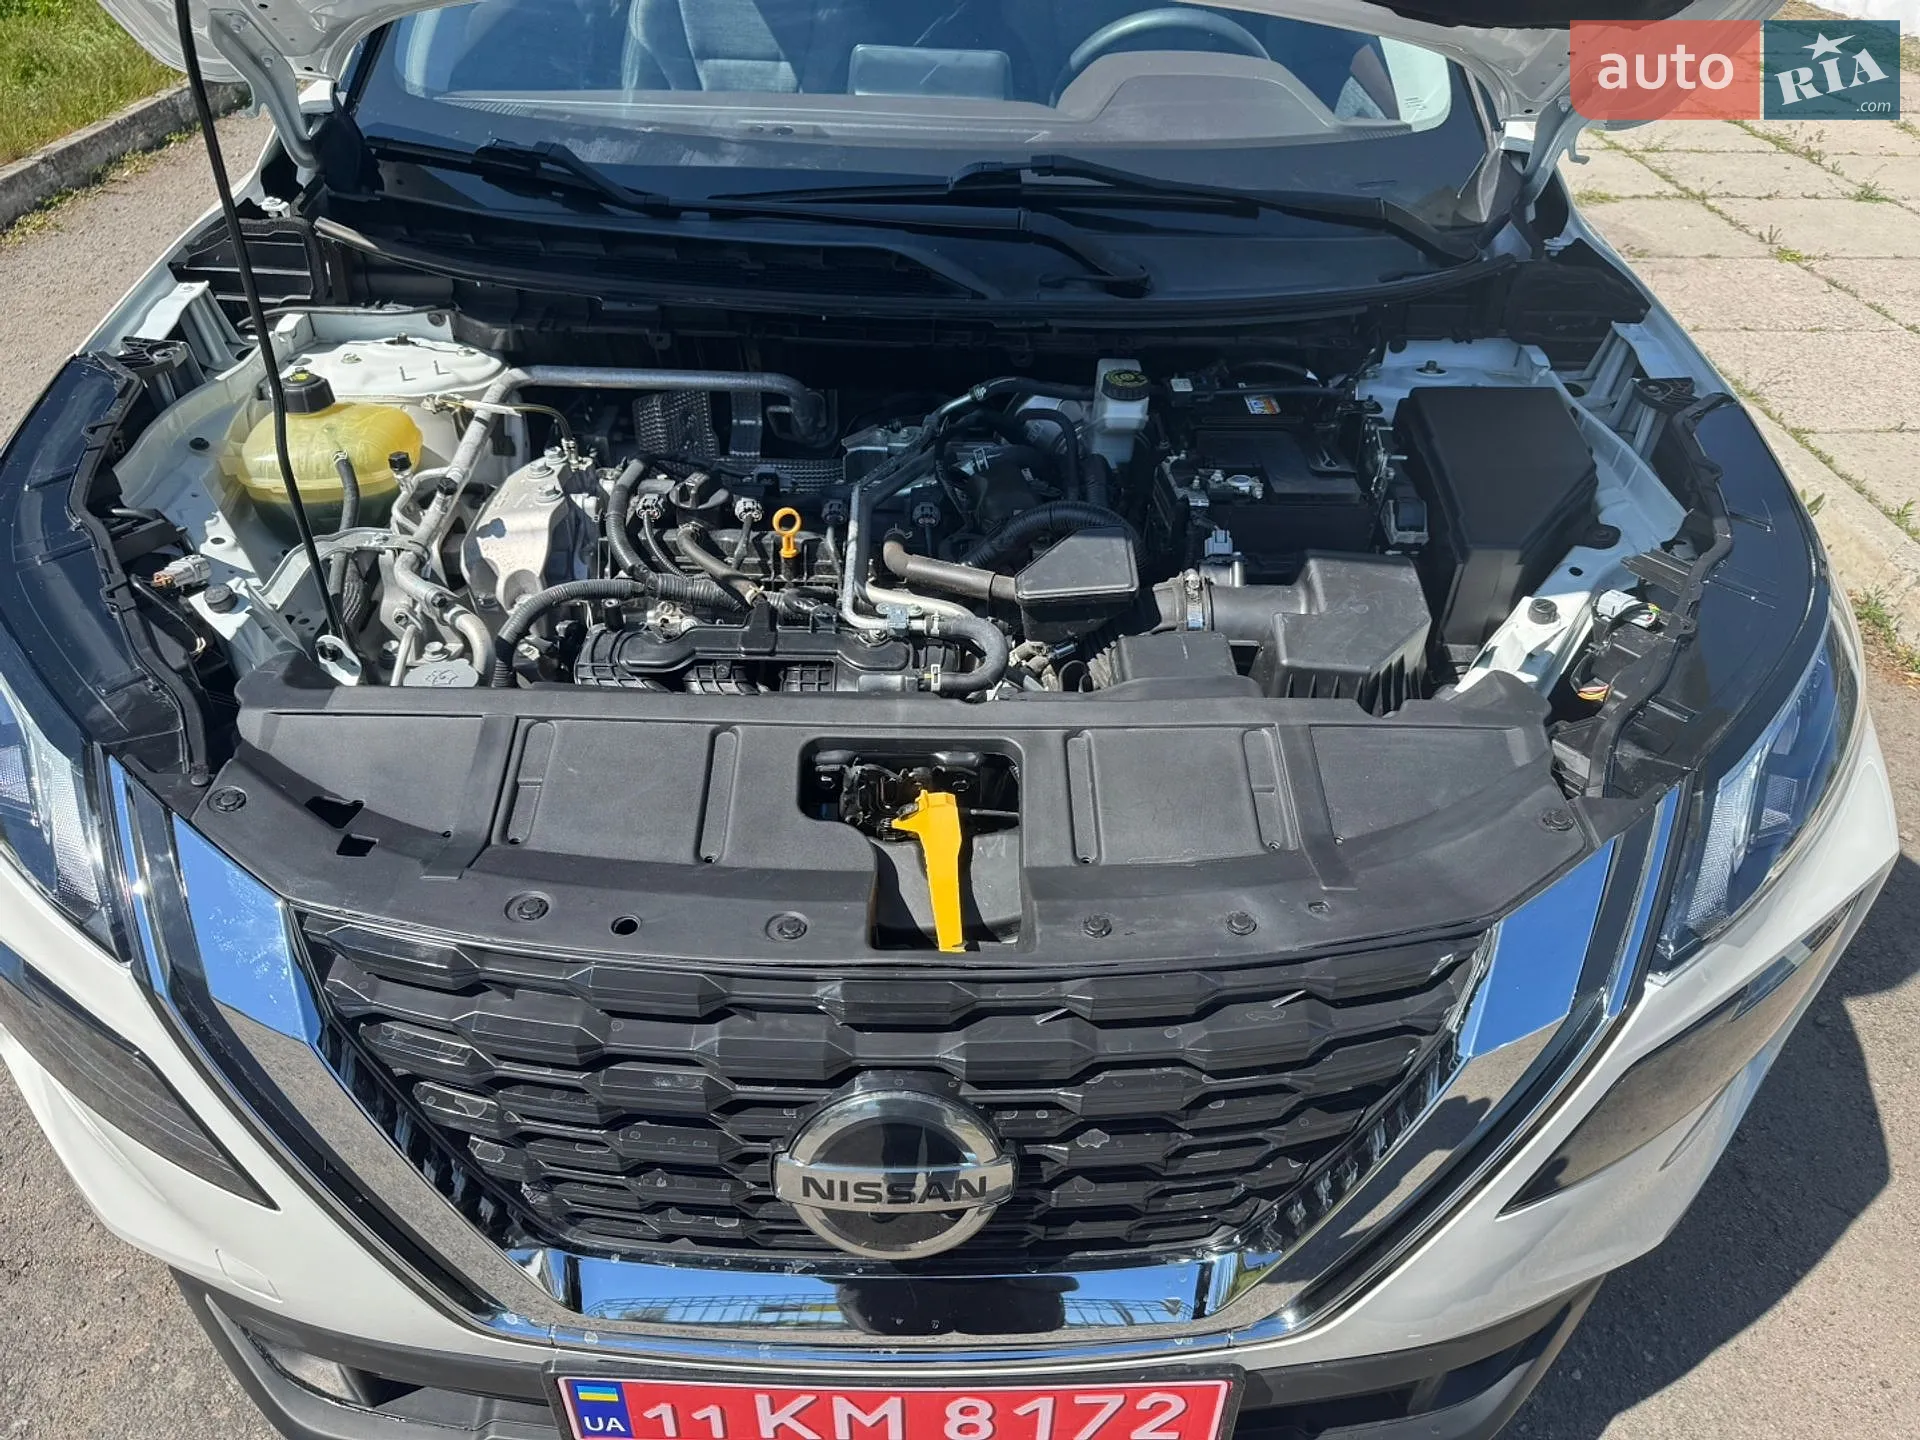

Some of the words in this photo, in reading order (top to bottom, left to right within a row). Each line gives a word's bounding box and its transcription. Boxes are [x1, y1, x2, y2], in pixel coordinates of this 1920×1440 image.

[802, 1176, 986, 1204] NISSAN
[584, 1416, 626, 1432] UA
[643, 1403, 725, 1438] 11
[755, 1393, 903, 1440] KM
[944, 1392, 1187, 1440] 8172
